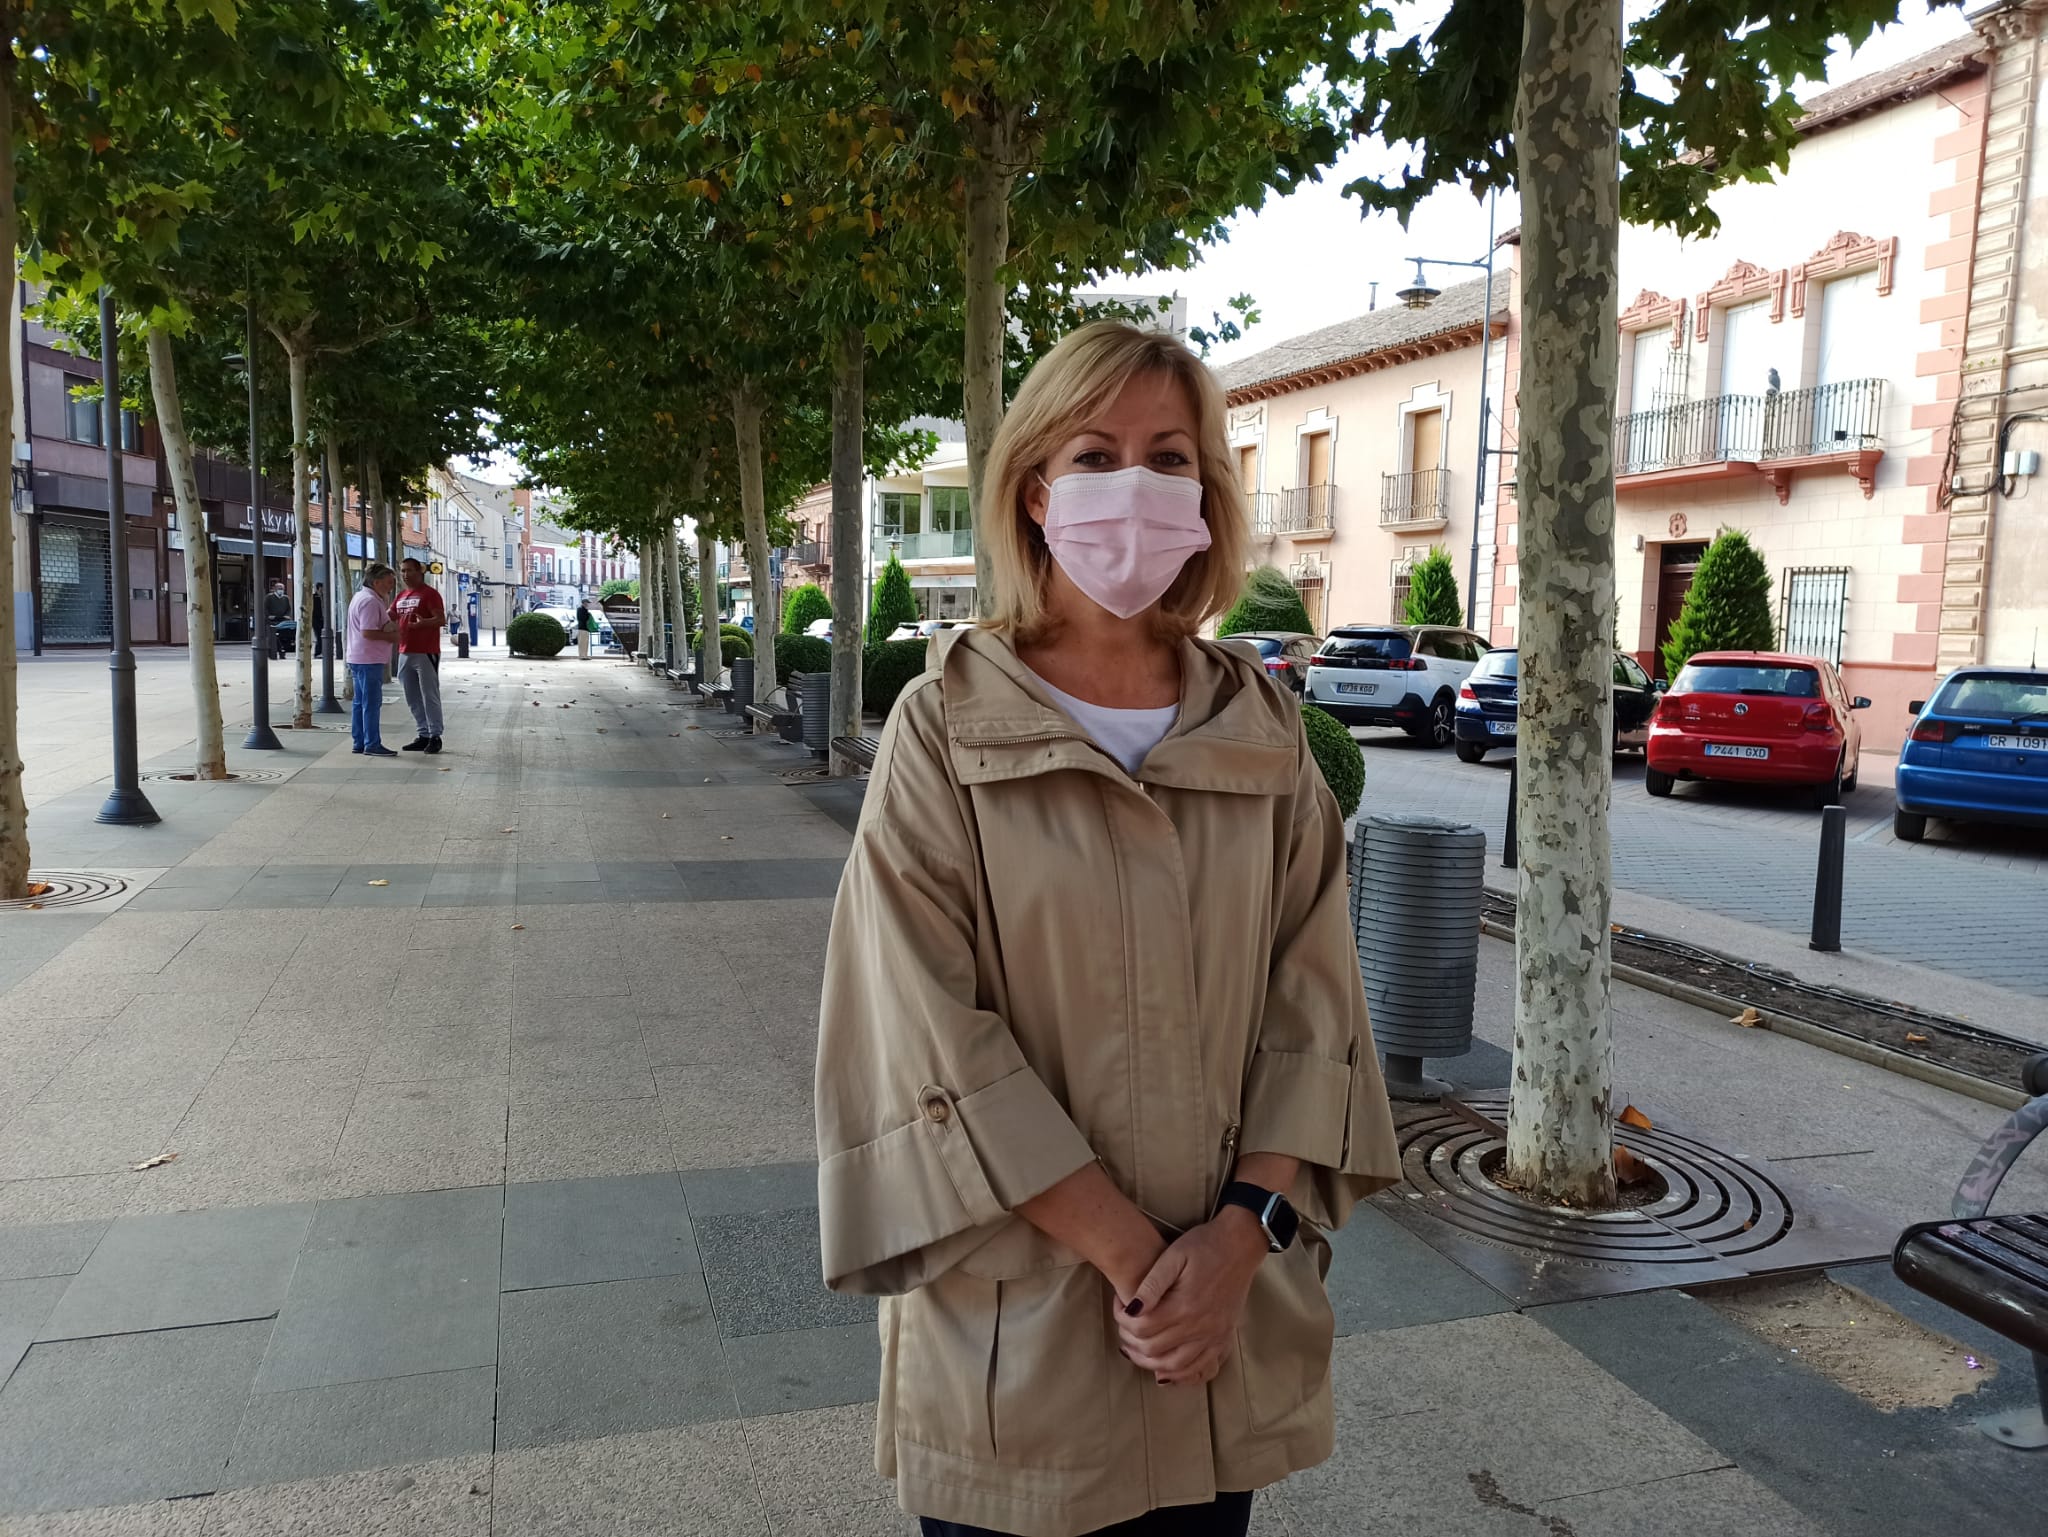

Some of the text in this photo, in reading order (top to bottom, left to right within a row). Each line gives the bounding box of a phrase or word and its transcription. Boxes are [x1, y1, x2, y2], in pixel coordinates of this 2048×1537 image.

[1990, 735, 2007, 746] CR
[1713, 745, 1766, 758] 7441 GXD
